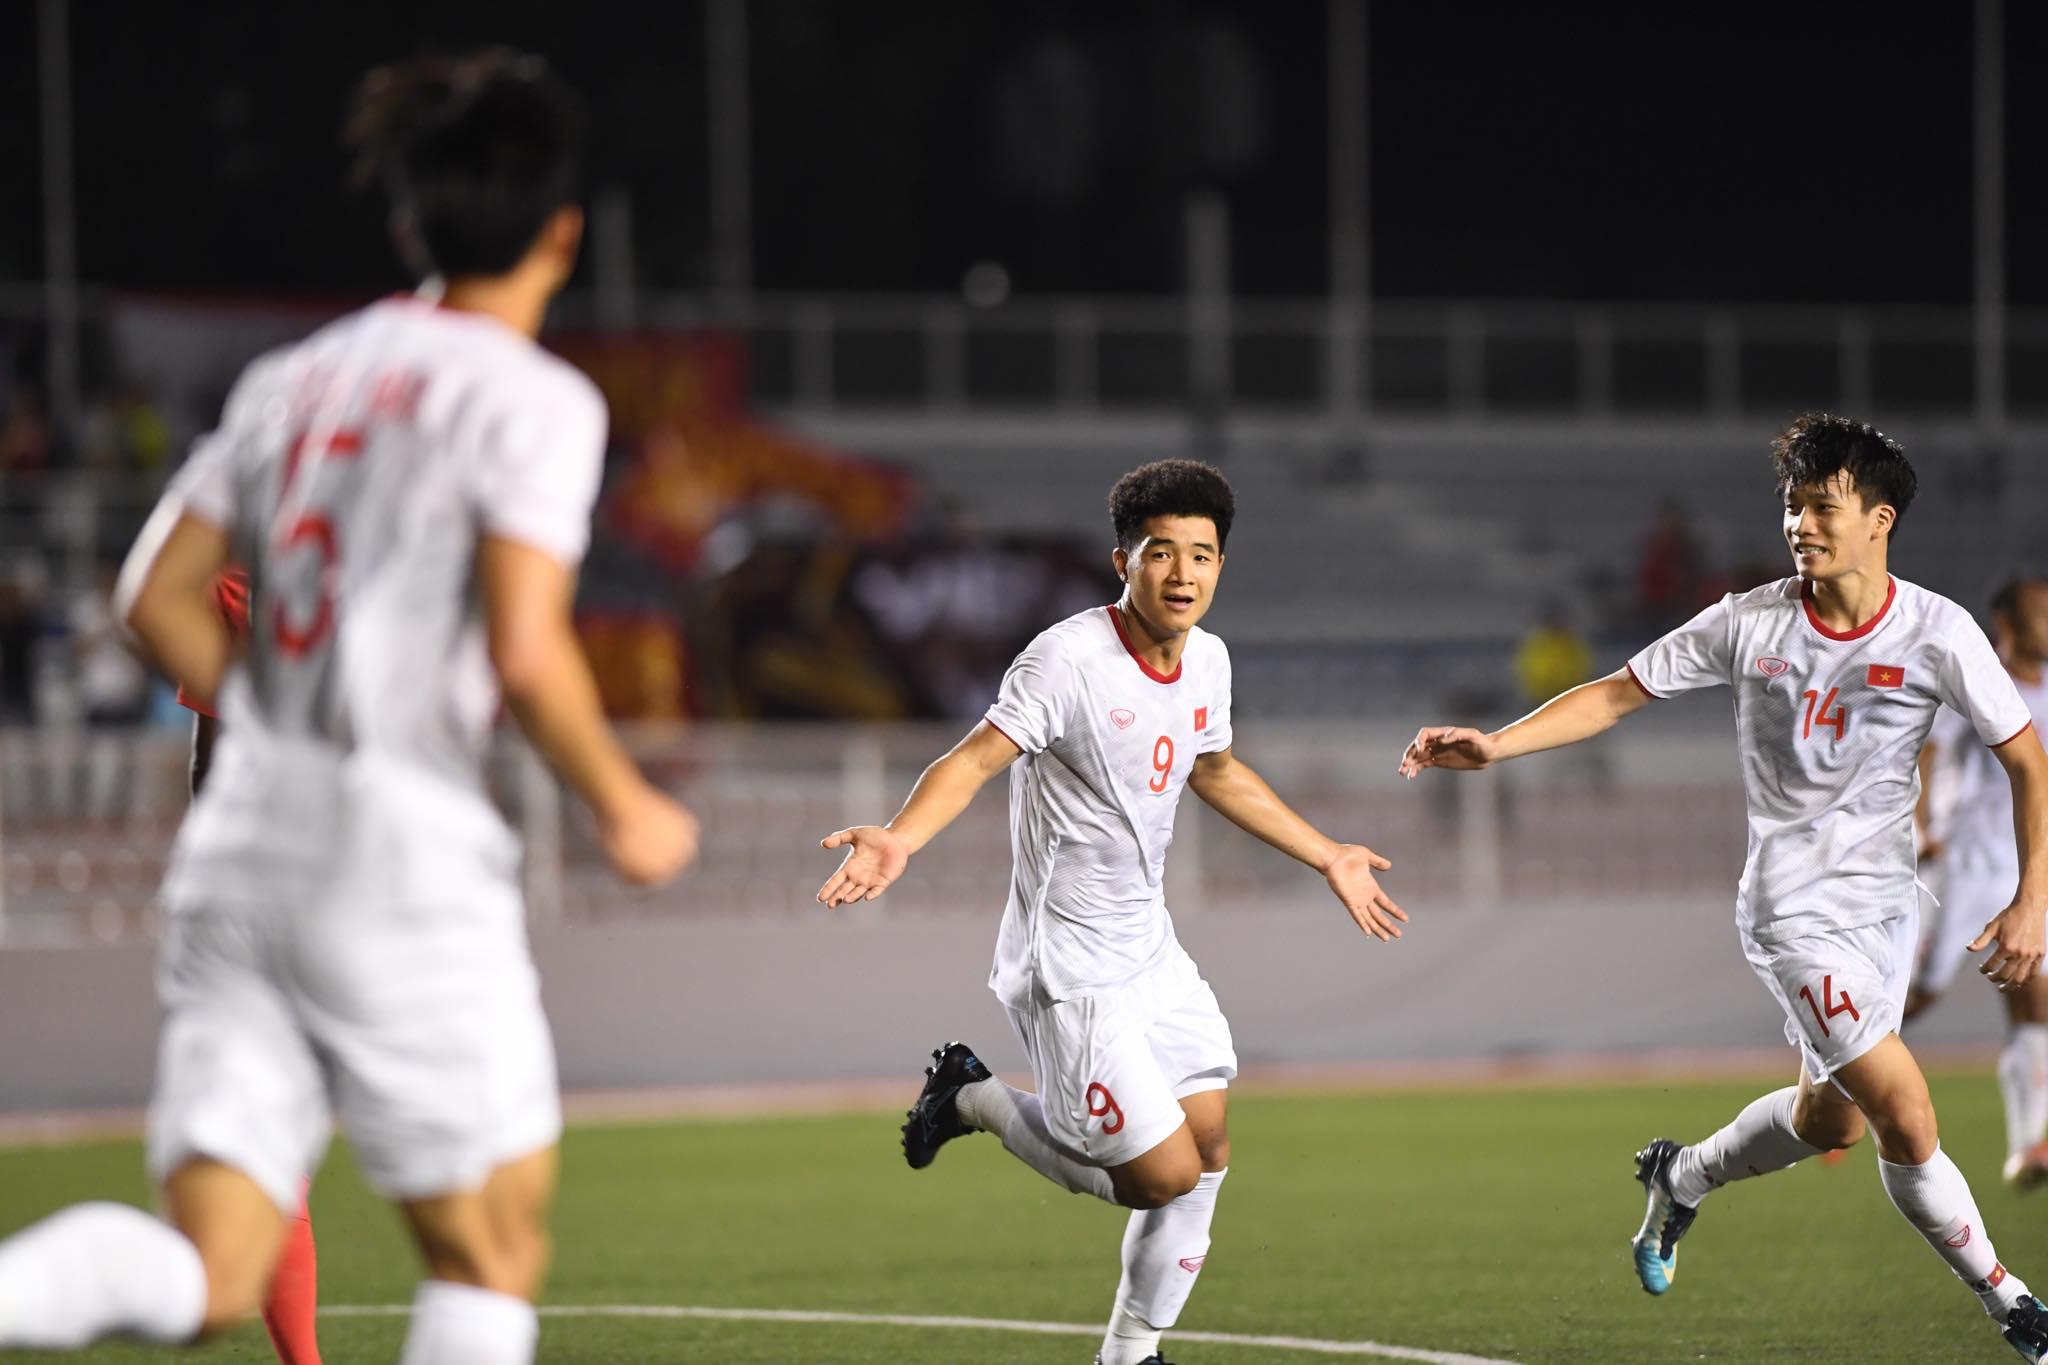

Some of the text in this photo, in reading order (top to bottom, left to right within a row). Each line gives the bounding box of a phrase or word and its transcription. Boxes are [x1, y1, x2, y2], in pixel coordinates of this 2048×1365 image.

[1802, 686, 1845, 741] 14
[1149, 735, 1174, 793] 9
[1799, 974, 1860, 1038] 14
[1085, 1081, 1125, 1135] 9
